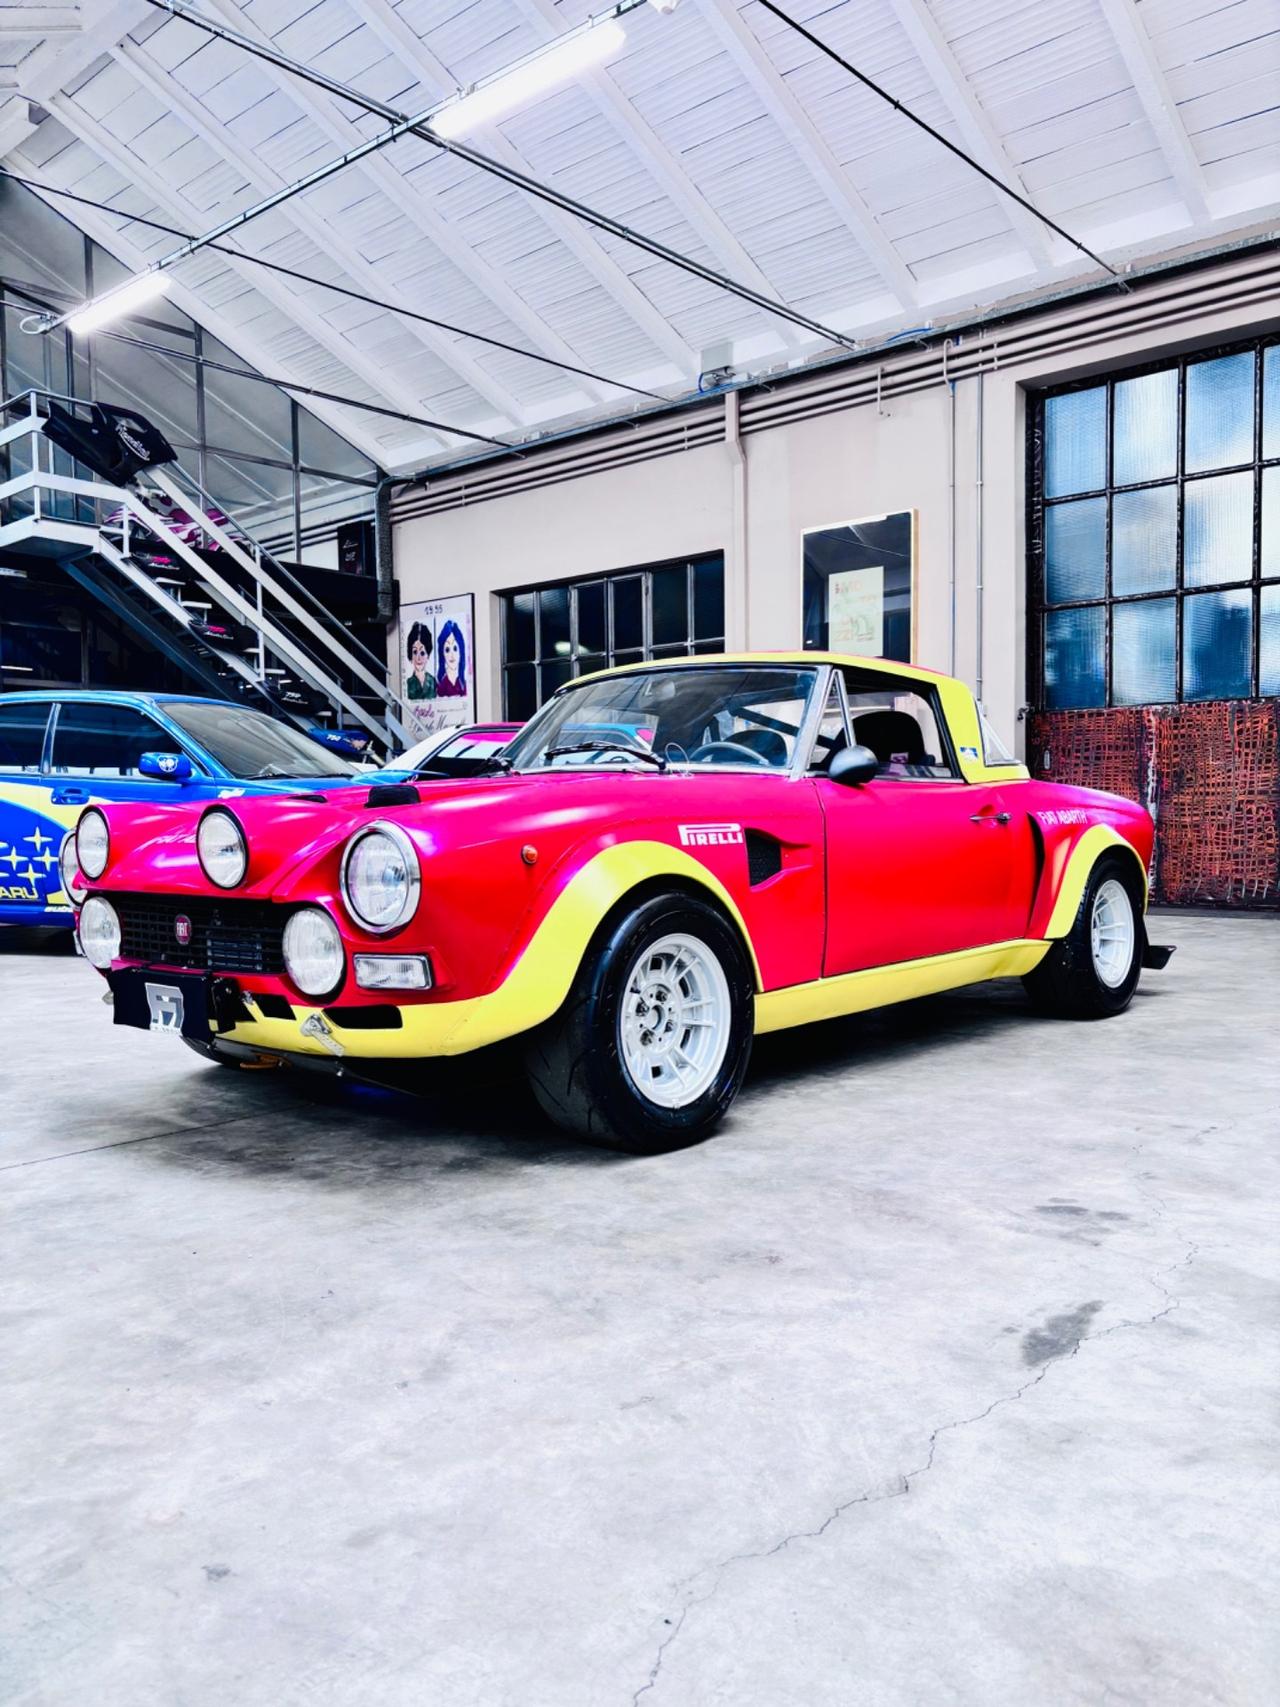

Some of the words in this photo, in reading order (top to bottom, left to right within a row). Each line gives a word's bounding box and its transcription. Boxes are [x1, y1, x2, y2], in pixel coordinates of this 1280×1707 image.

[1037, 810, 1058, 824] FIAT
[1056, 809, 1088, 824] ABARTH
[677, 823, 743, 846] PIRELLI
[176, 922, 188, 936] FIAT
